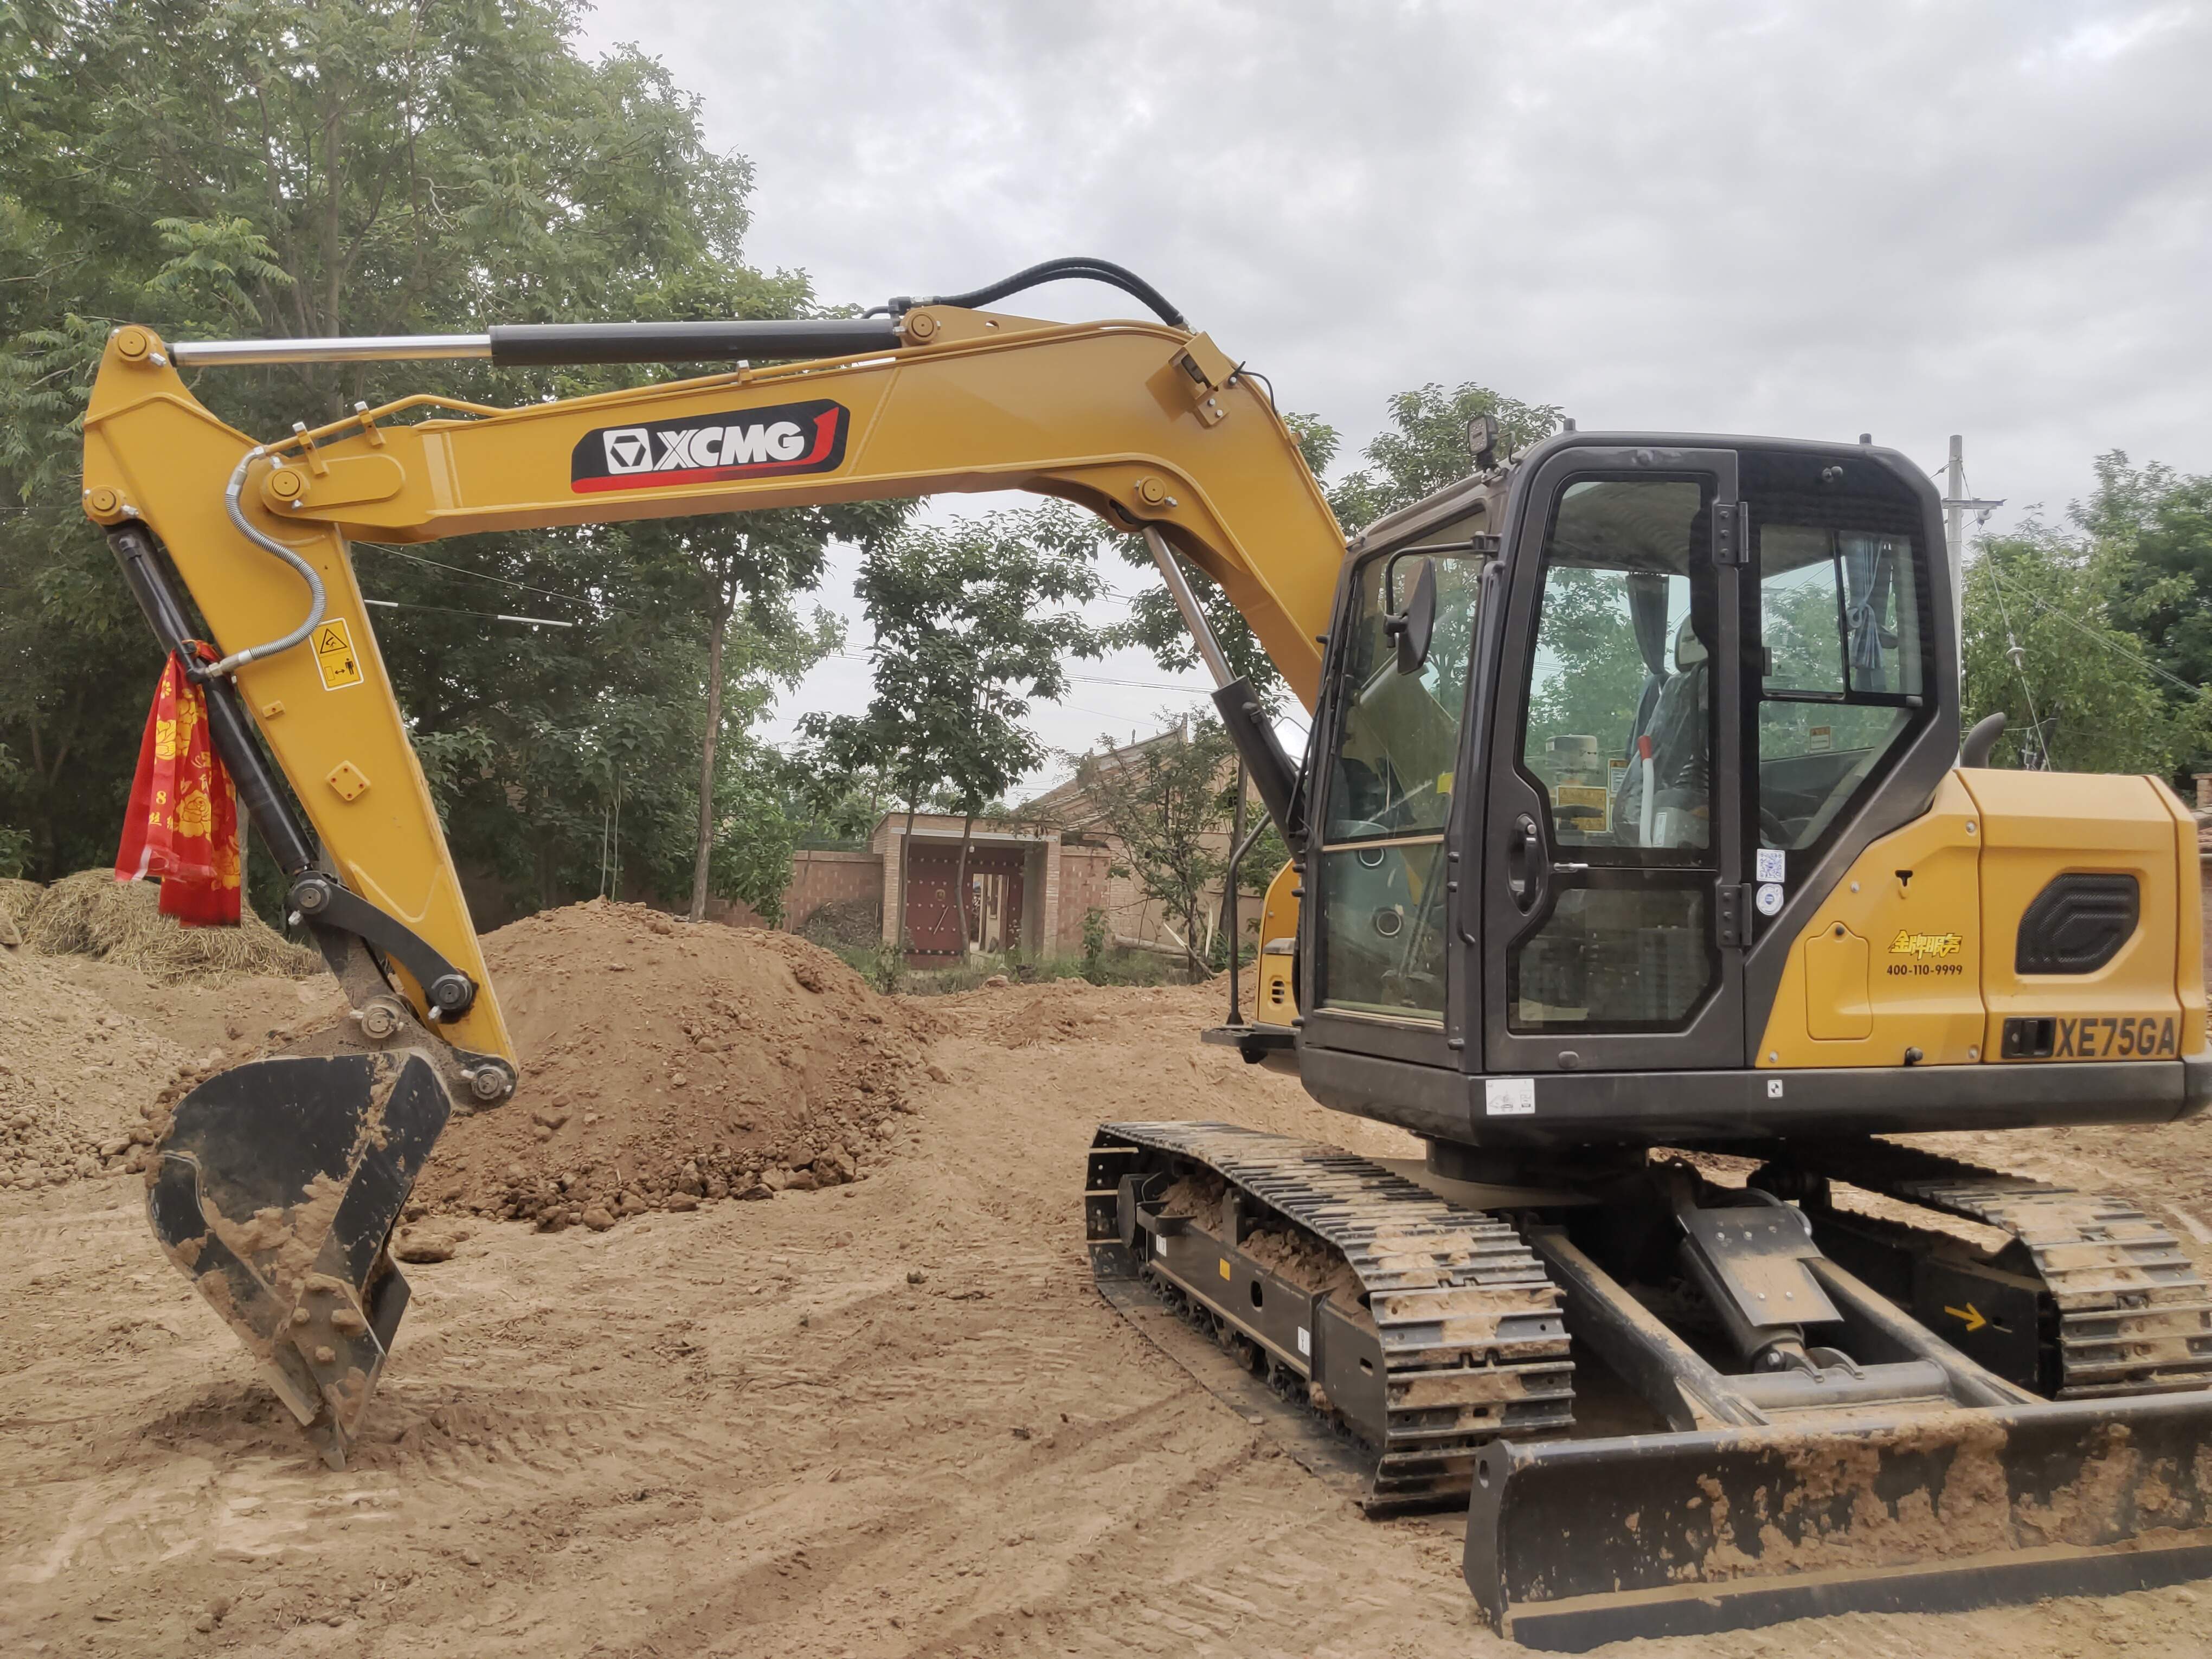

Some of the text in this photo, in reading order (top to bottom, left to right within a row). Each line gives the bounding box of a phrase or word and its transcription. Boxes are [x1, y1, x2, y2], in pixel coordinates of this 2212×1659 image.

[654, 421, 804, 471] XCMG
[156, 790, 166, 805] 8
[1888, 929, 1963, 961] 金牌服务
[1887, 964, 1963, 975] 400-110-9999
[2056, 1017, 2175, 1057] XE75GA
